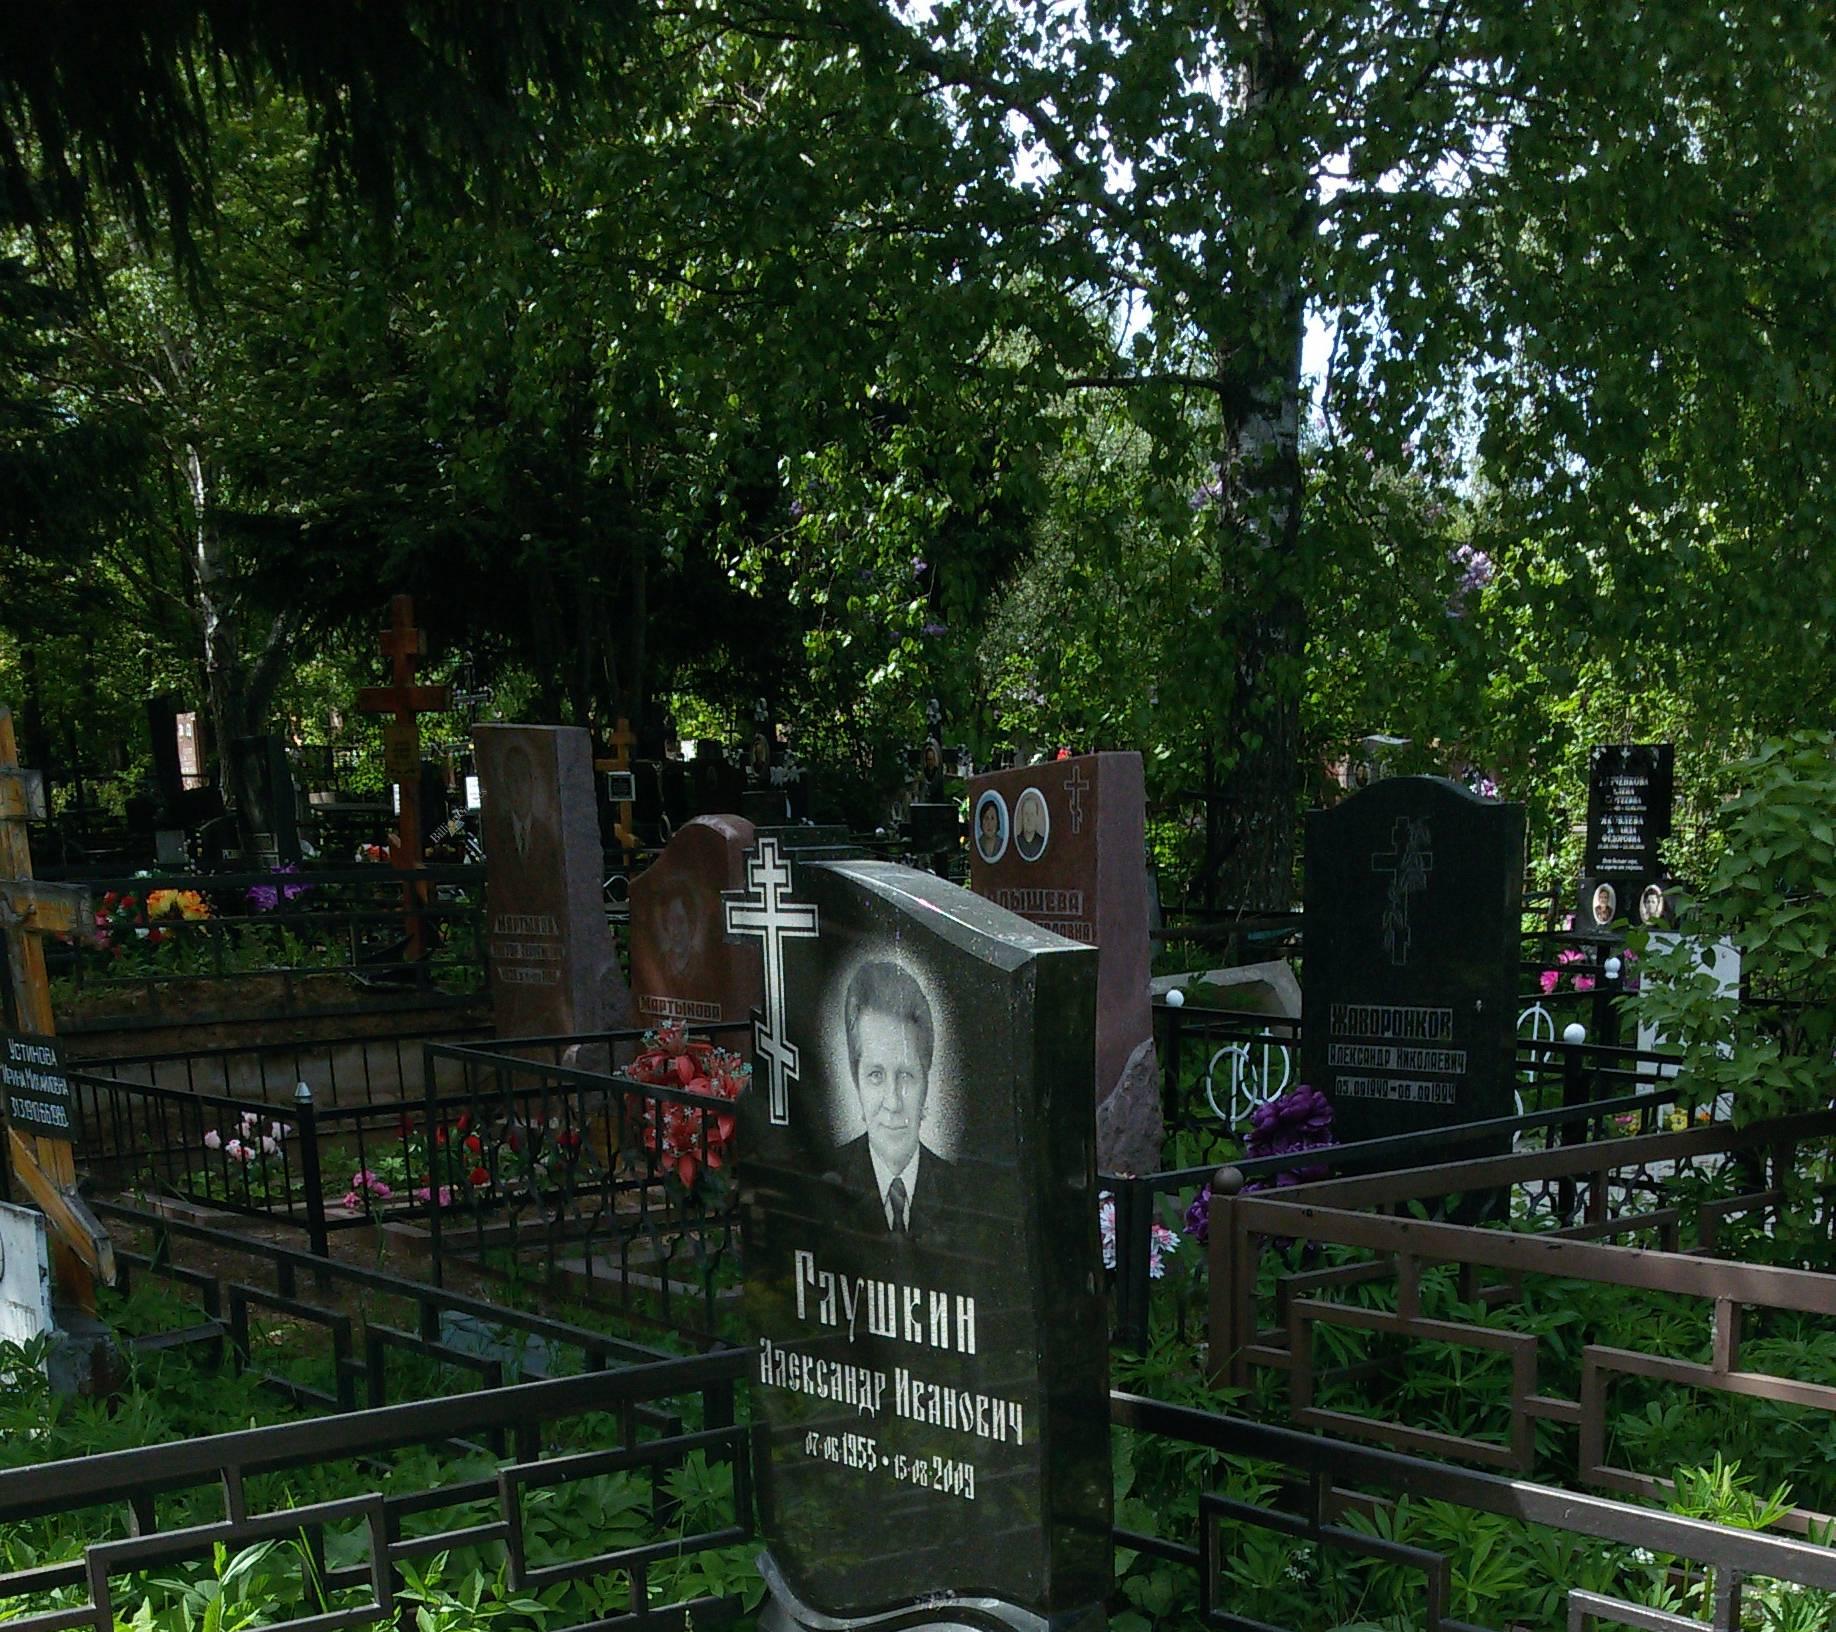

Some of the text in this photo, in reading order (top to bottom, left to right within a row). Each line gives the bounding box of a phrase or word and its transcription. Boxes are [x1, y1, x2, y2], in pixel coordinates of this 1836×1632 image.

[1331, 1004, 1452, 1039] ЖАВОРОНКОВ
[8, 1038, 58, 1067] УСТИНОВА
[1330, 1044, 1465, 1073] АЛЕКСАНДР НИКОЛАЕВИЧ
[759, 1337, 1023, 1446] Александр Иванович
